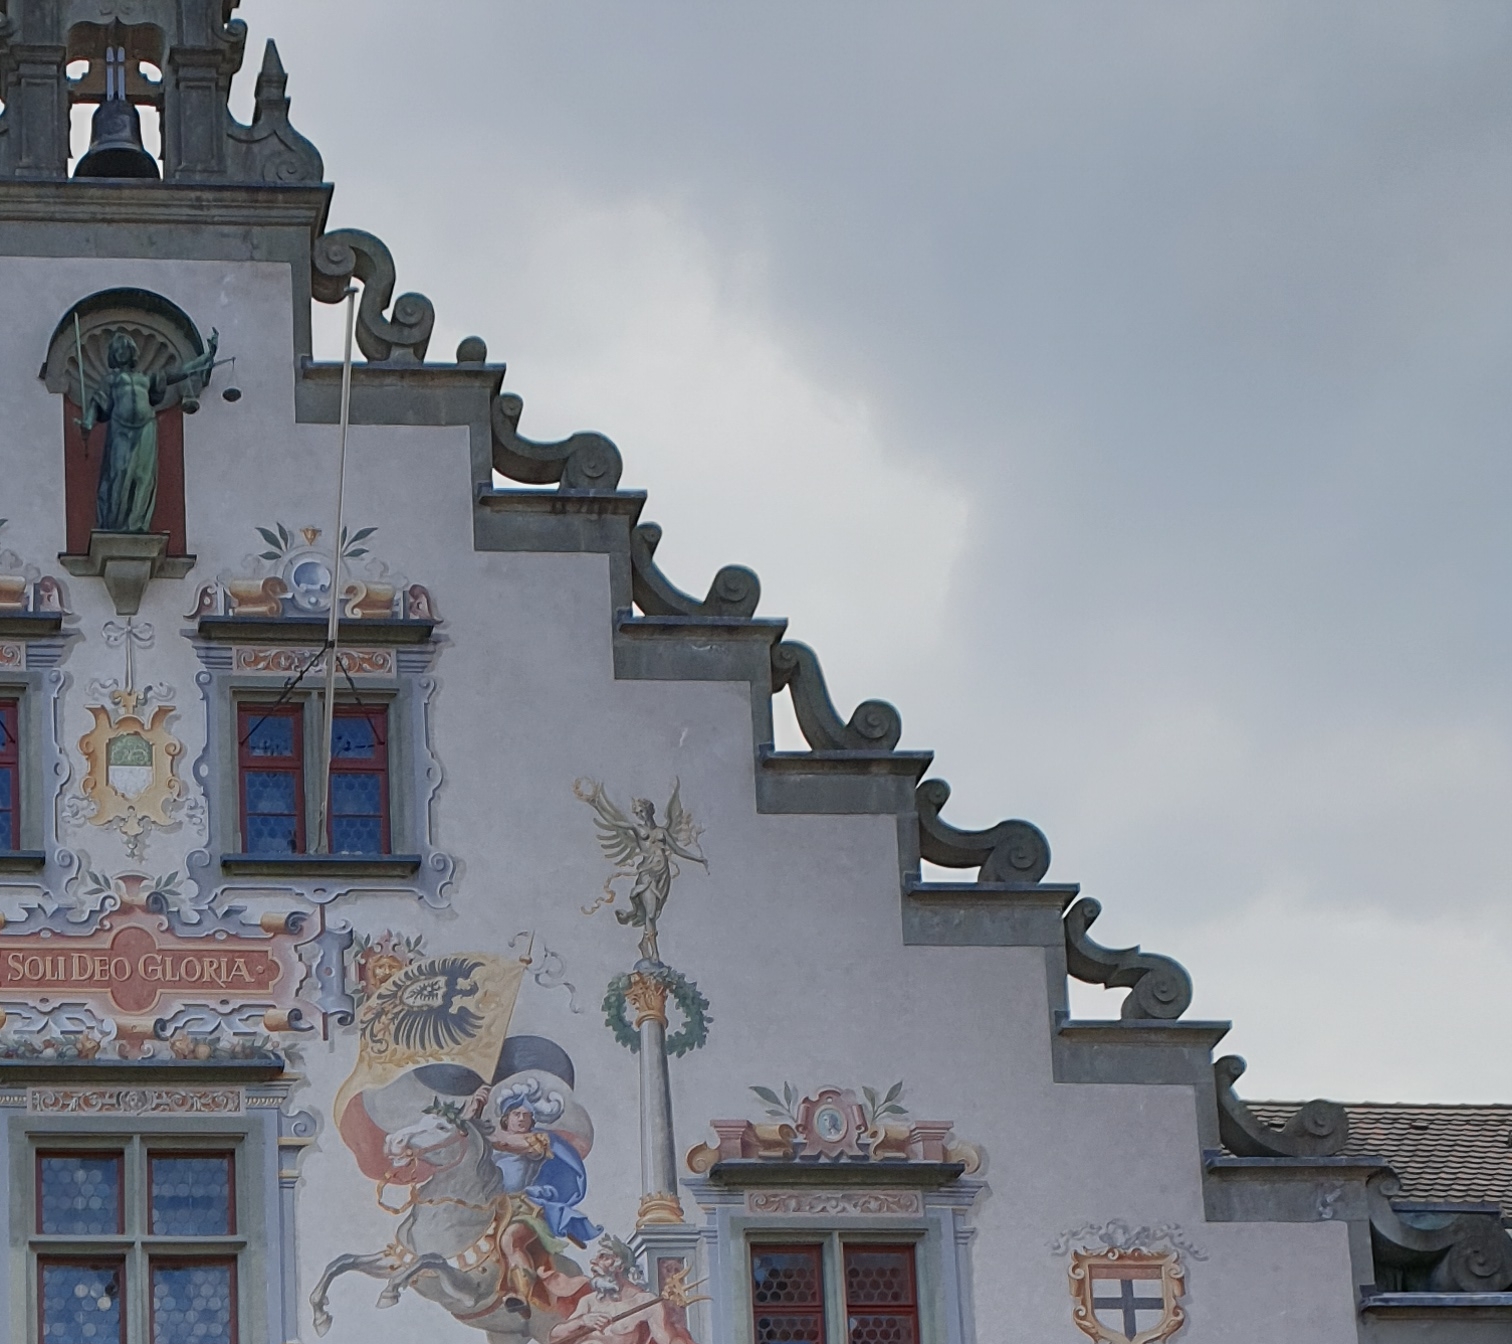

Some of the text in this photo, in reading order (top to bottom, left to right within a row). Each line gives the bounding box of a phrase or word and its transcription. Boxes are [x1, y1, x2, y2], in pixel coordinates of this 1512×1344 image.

[7, 951, 255, 989] SOLI DEO GLORIA
